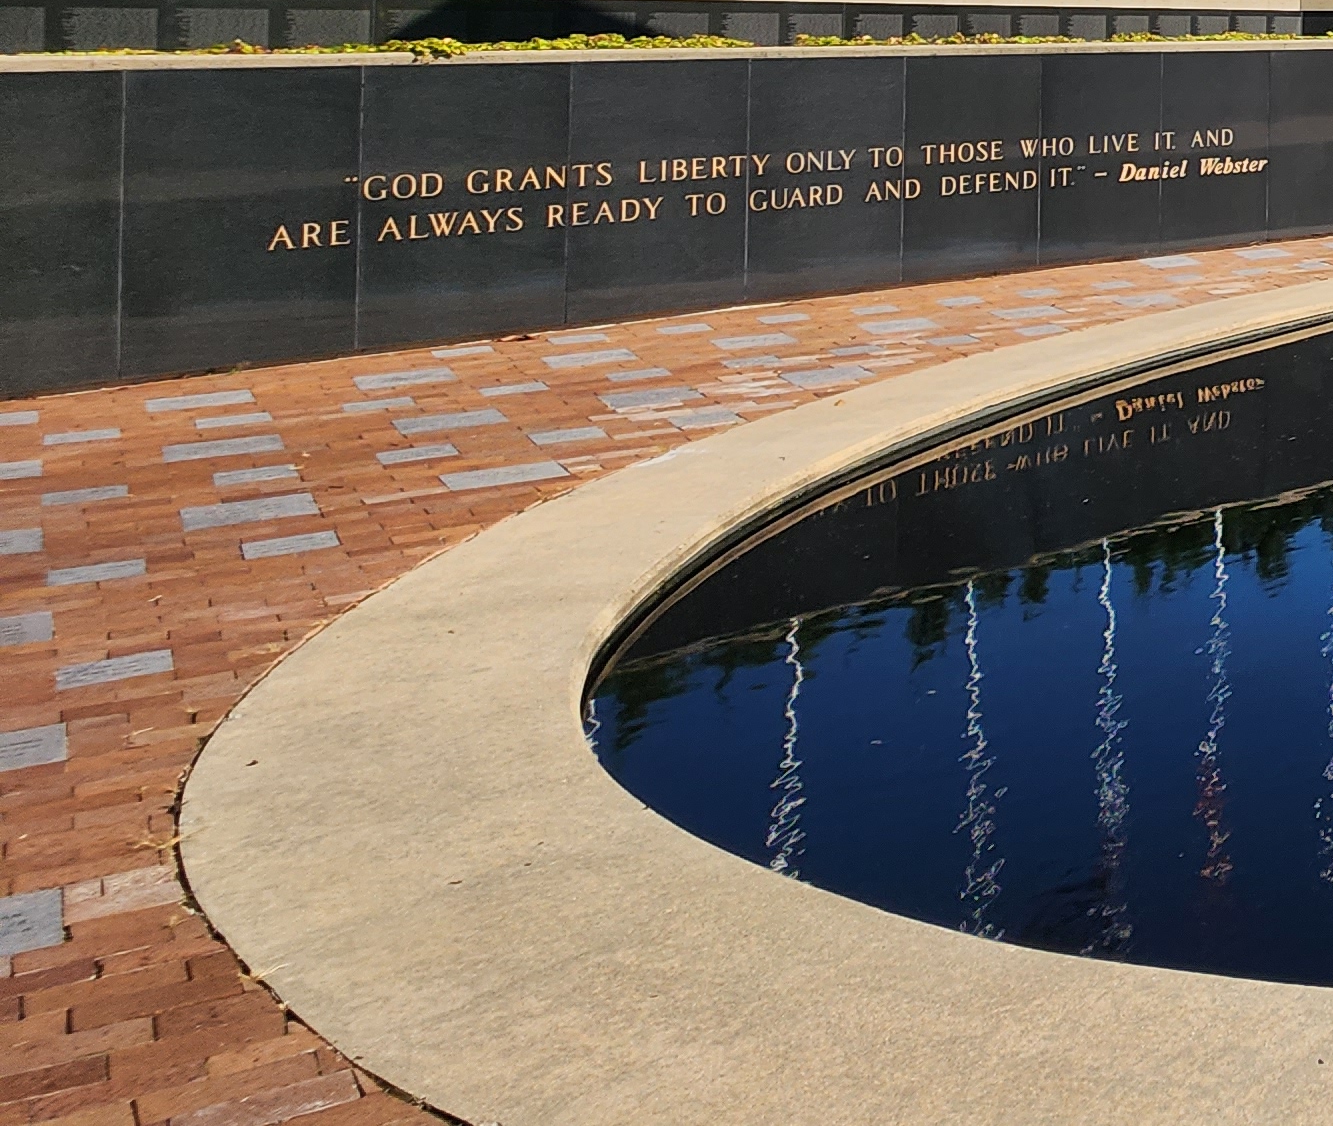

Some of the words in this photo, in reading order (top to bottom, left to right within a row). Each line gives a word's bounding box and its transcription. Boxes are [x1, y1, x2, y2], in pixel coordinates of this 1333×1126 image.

[466, 161, 614, 195] GRANTS
[639, 153, 771, 183] LIBERTY
[786, 147, 857, 175] ONLY
[869, 146, 903, 169] TO
[920, 140, 1004, 166] THOSE
[1020, 136, 1075, 157] WHO
[1089, 132, 1140, 154] LIVE
[1190, 128, 1234, 148] AND
[267, 219, 351, 251] ARE
[378, 206, 525, 242] ALWAYS
[546, 195, 665, 229] READY
[684, 192, 727, 216] TO
[749, 184, 843, 212] GUARD
[864, 177, 921, 202] AND
[940, 168, 1037, 197] DEFEND
[1118, 160, 1188, 182] Daniel
[1199, 157, 1268, 176] Webster
